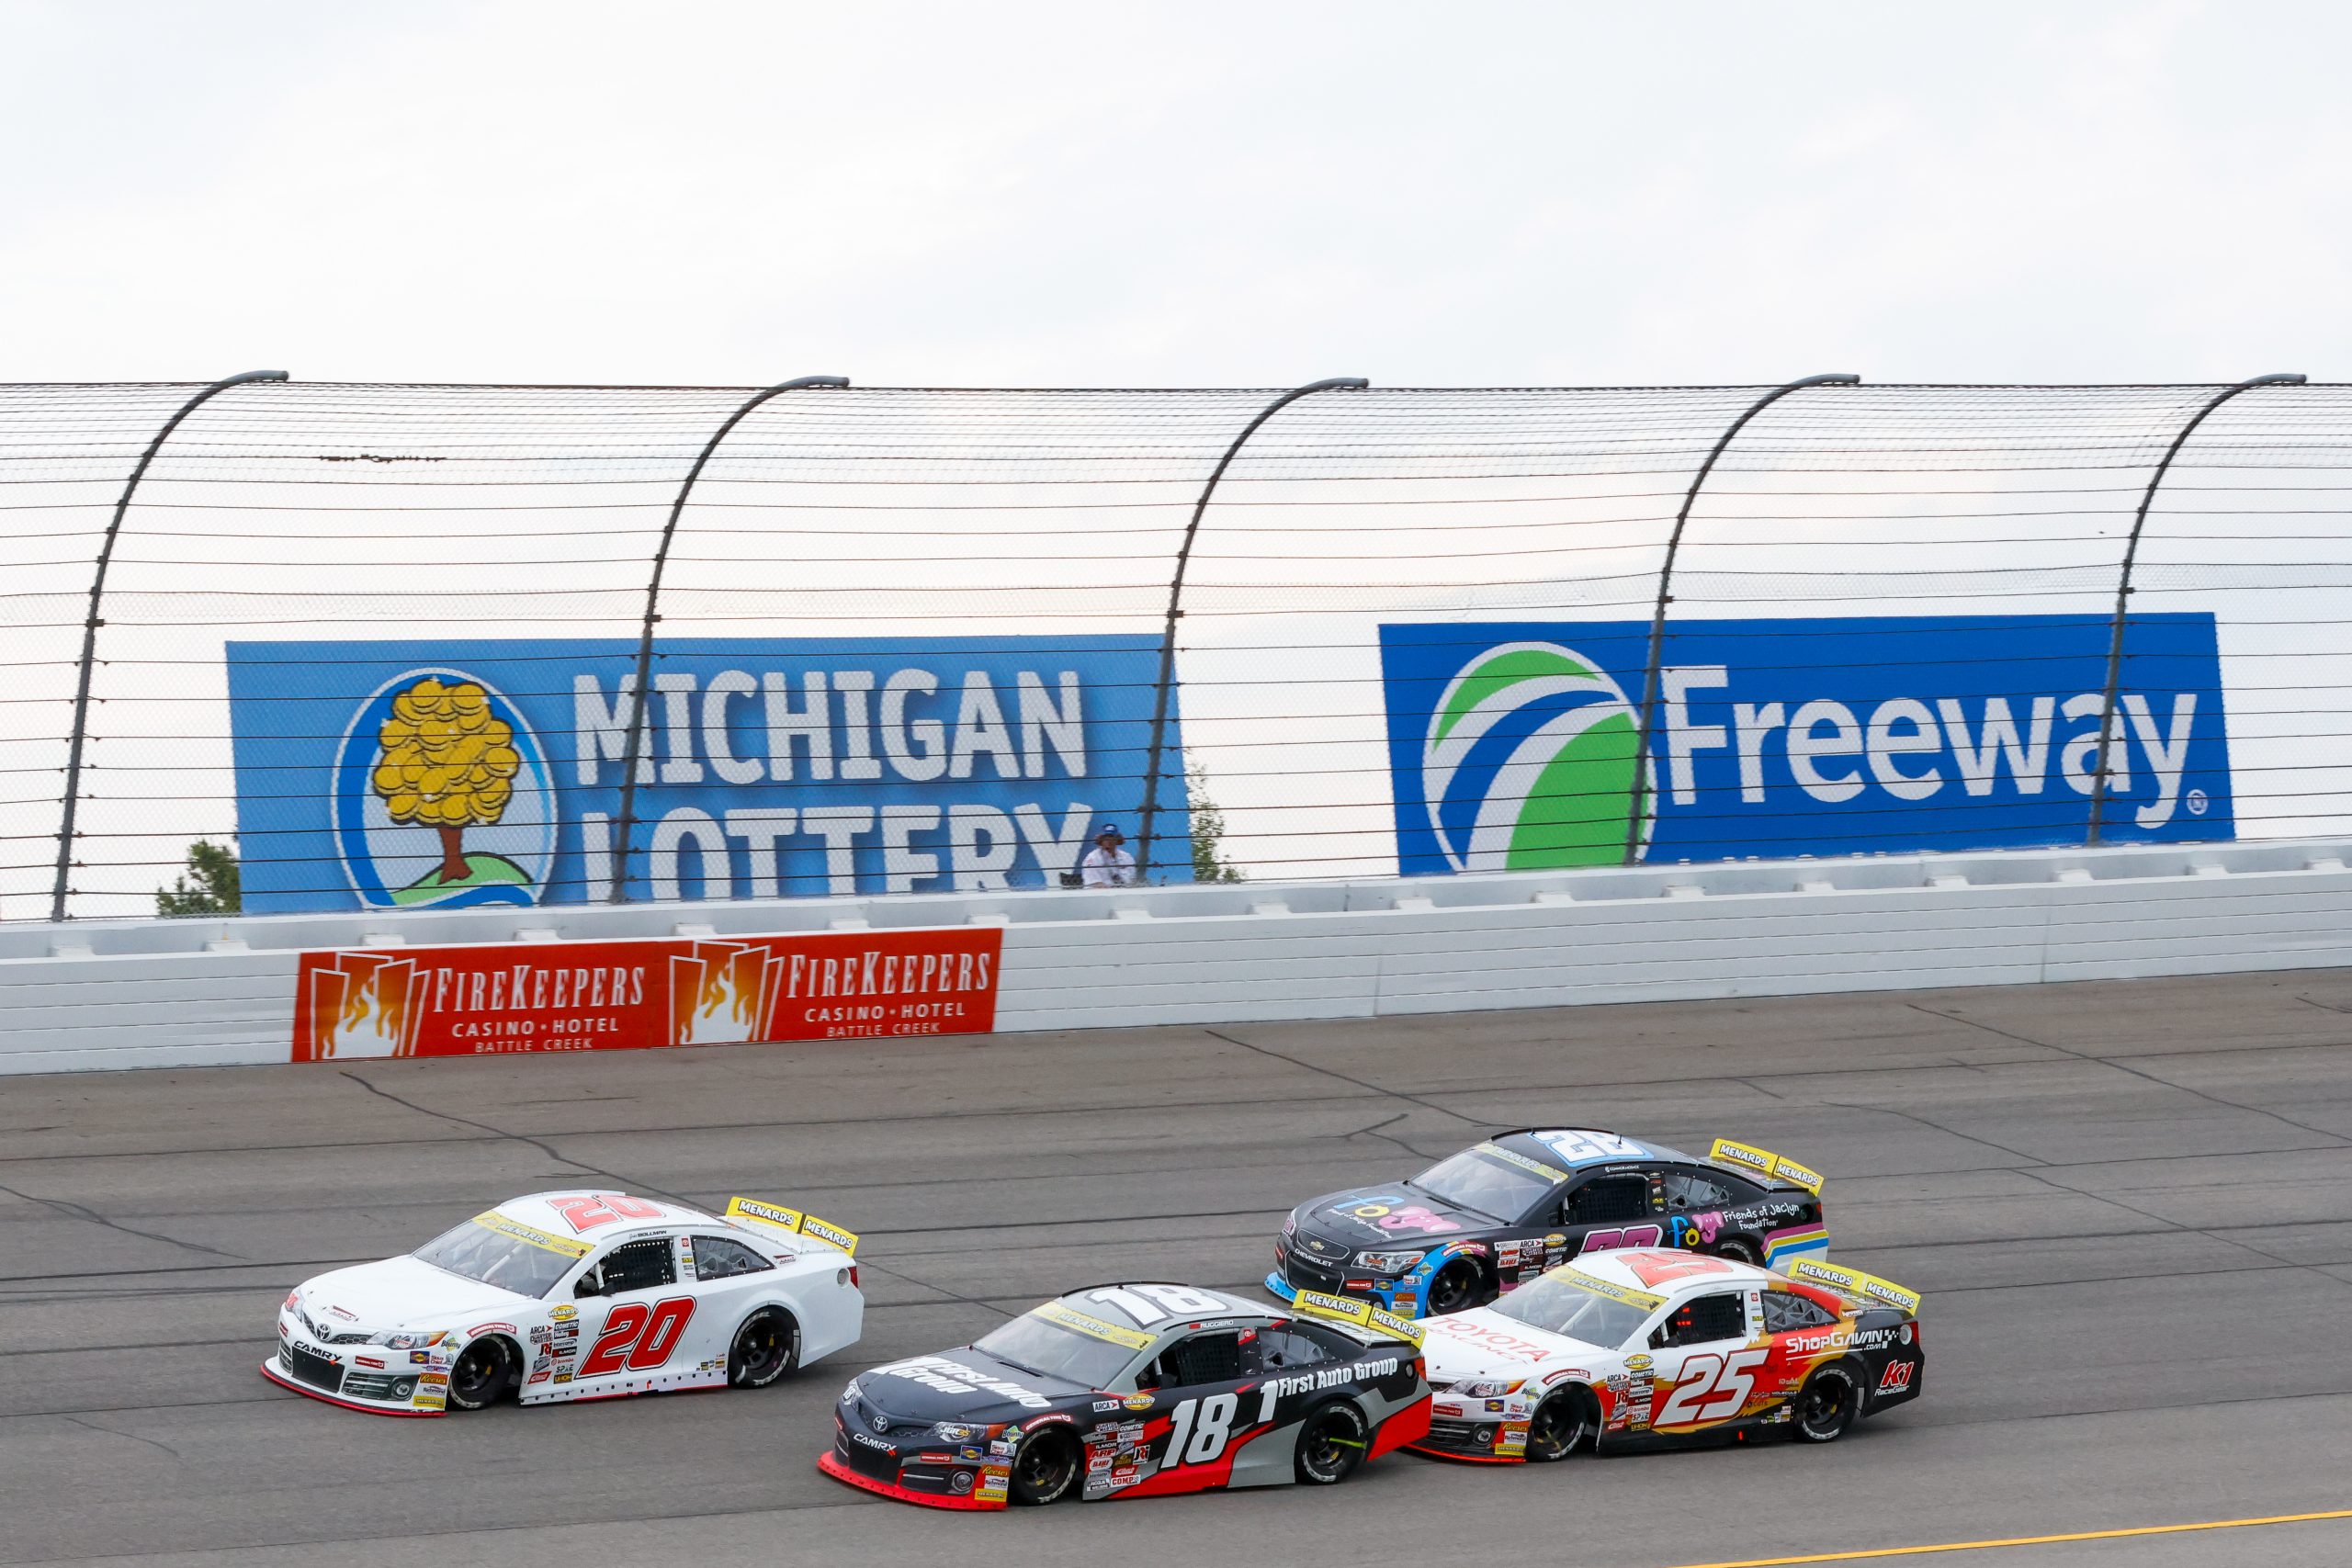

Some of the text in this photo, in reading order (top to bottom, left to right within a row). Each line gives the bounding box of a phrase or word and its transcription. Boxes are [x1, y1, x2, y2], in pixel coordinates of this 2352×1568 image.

[574, 668, 1087, 785] MICHIGAN
[1661, 664, 2199, 829] Freeway
[805, 1002, 966, 1023] CASINO HOTEL
[451, 1018, 619, 1038] CASINO HOTEL
[827, 1021, 941, 1038] BATTLE CREEK
[475, 1037, 594, 1054] BATTLE CREEK
[1719, 1144, 1768, 1168] MENARDS
[1777, 1163, 1820, 1187] MENARDS
[546, 1194, 665, 1235] 20
[739, 1201, 795, 1225] MENARDS
[1722, 1202, 1800, 1223] Friends of Jaclyn
[497, 1223, 552, 1246] MENARDS
[637, 1229, 667, 1238] BOLLMAN
[804, 1219, 854, 1249] MENARDS
[1738, 1218, 1778, 1231] Foundation
[1521, 1240, 1535, 1248] ARCA
[1295, 1247, 1333, 1268] CHEVROLET
[1797, 1262, 1854, 1286] MENARDS
[1571, 1276, 1625, 1298] MENARDS
[1864, 1282, 1916, 1308] MENARDS
[548, 1307, 579, 1318] MENARDS
[1083, 1285, 1233, 1330] 18
[1303, 1292, 1362, 1315] MENARDS
[530, 1325, 546, 1336] ARCA
[555, 1321, 579, 1330] COMETIC
[1057, 1313, 1113, 1336] MENARDS
[1201, 1320, 1234, 1329] RUGGIERO
[1372, 1310, 1422, 1339] MENARDS
[441, 1339, 461, 1349] Bounty
[575, 1294, 697, 1380] 20
[1432, 1317, 1551, 1362] TOYOTA
[294, 1341, 343, 1361] CAMRY
[1623, 1358, 1655, 1367] MENARDS
[1607, 1373, 1622, 1382] ARCA
[1631, 1370, 1654, 1379] COMETIC
[1880, 1359, 1915, 1388] K1
[1258, 1357, 1399, 1424] 1 First Auto Group
[1521, 1387, 1541, 1400] Bounty
[1654, 1347, 1770, 1426] 25
[1094, 1401, 1111, 1412] ARCA
[1123, 1396, 1156, 1405] MENARDS
[1001, 1428, 1024, 1440] Bounty
[1120, 1423, 1144, 1431] COMETIC
[1160, 1392, 1239, 1470] 18
[853, 1433, 897, 1451] CAMRY
[1090, 1449, 1116, 1459] ARP
[1112, 1476, 1134, 1485] COMP
